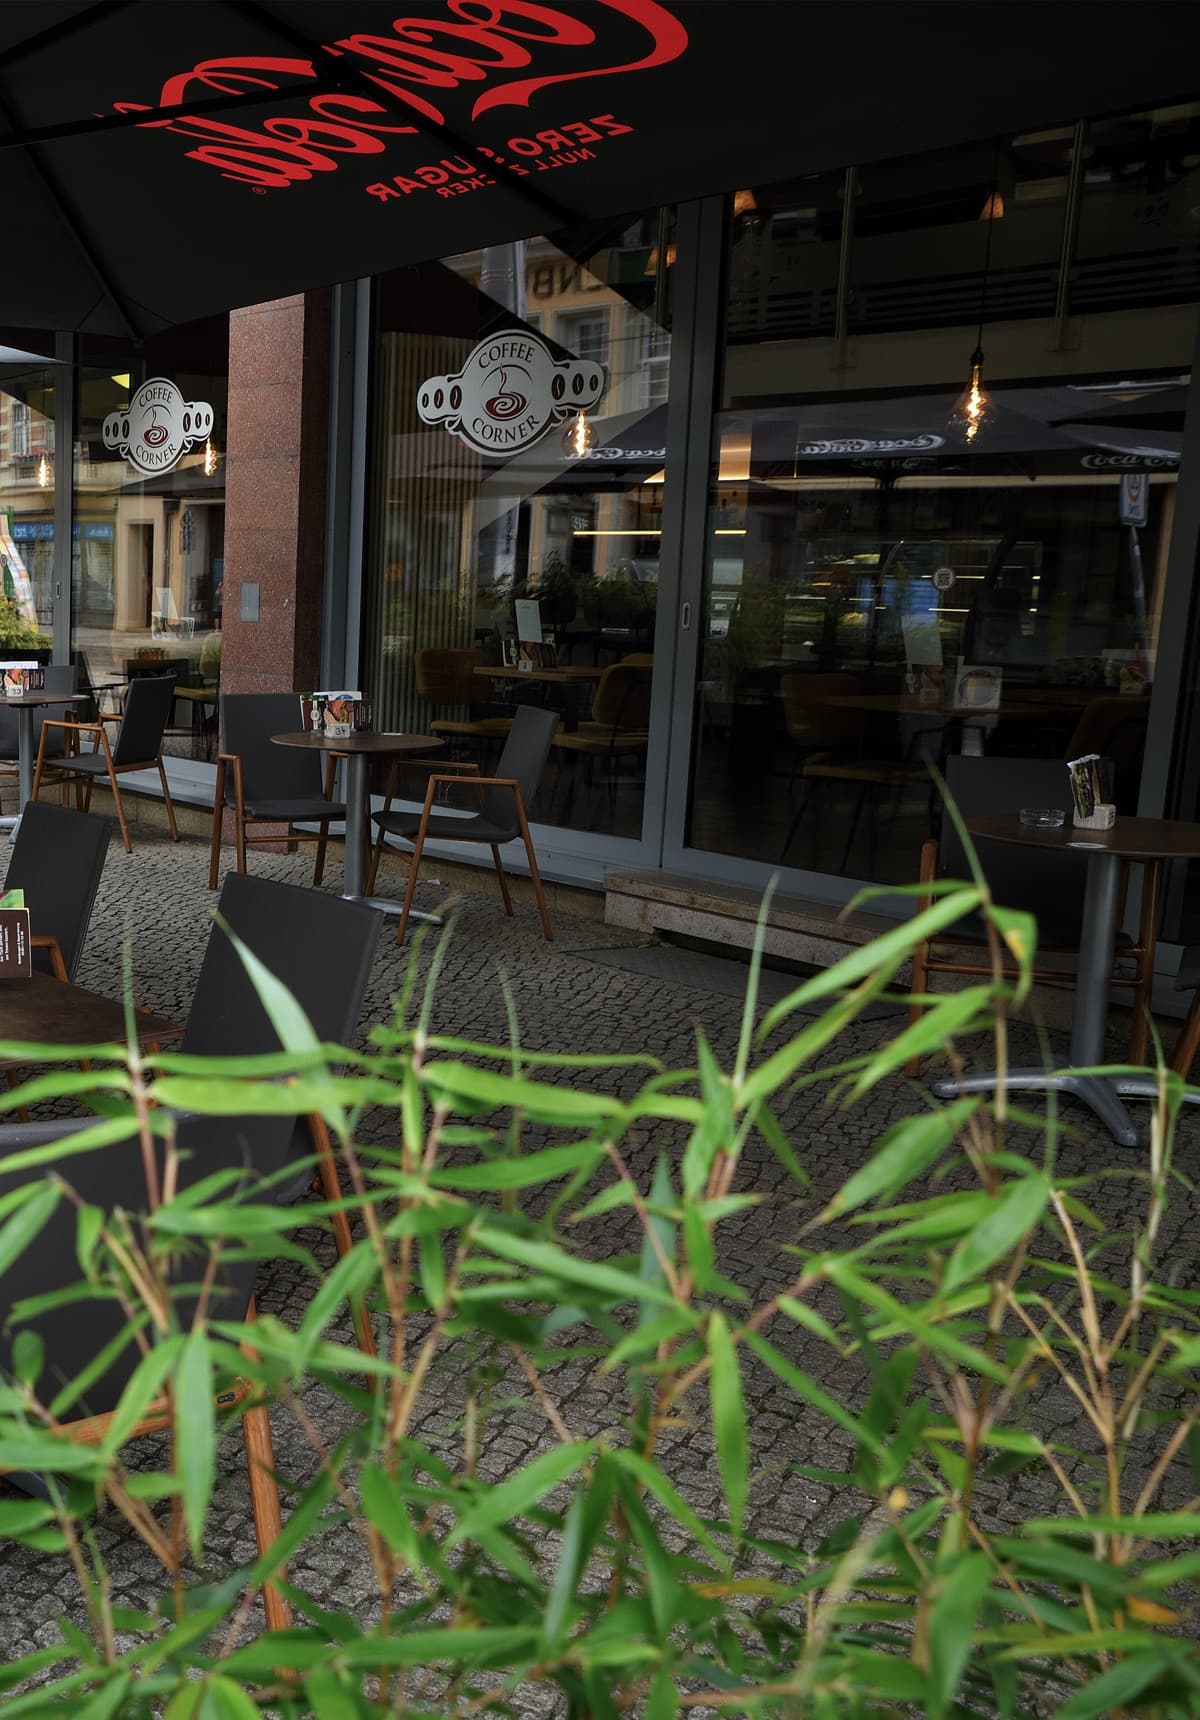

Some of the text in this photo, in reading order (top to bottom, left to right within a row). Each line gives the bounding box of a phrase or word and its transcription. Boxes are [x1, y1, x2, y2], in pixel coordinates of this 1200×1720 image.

[478, 342, 535, 368] COFFEE
[139, 387, 173, 407] COFFEE
[472, 415, 540, 443] CORNER
[135, 443, 177, 465] CORNER
